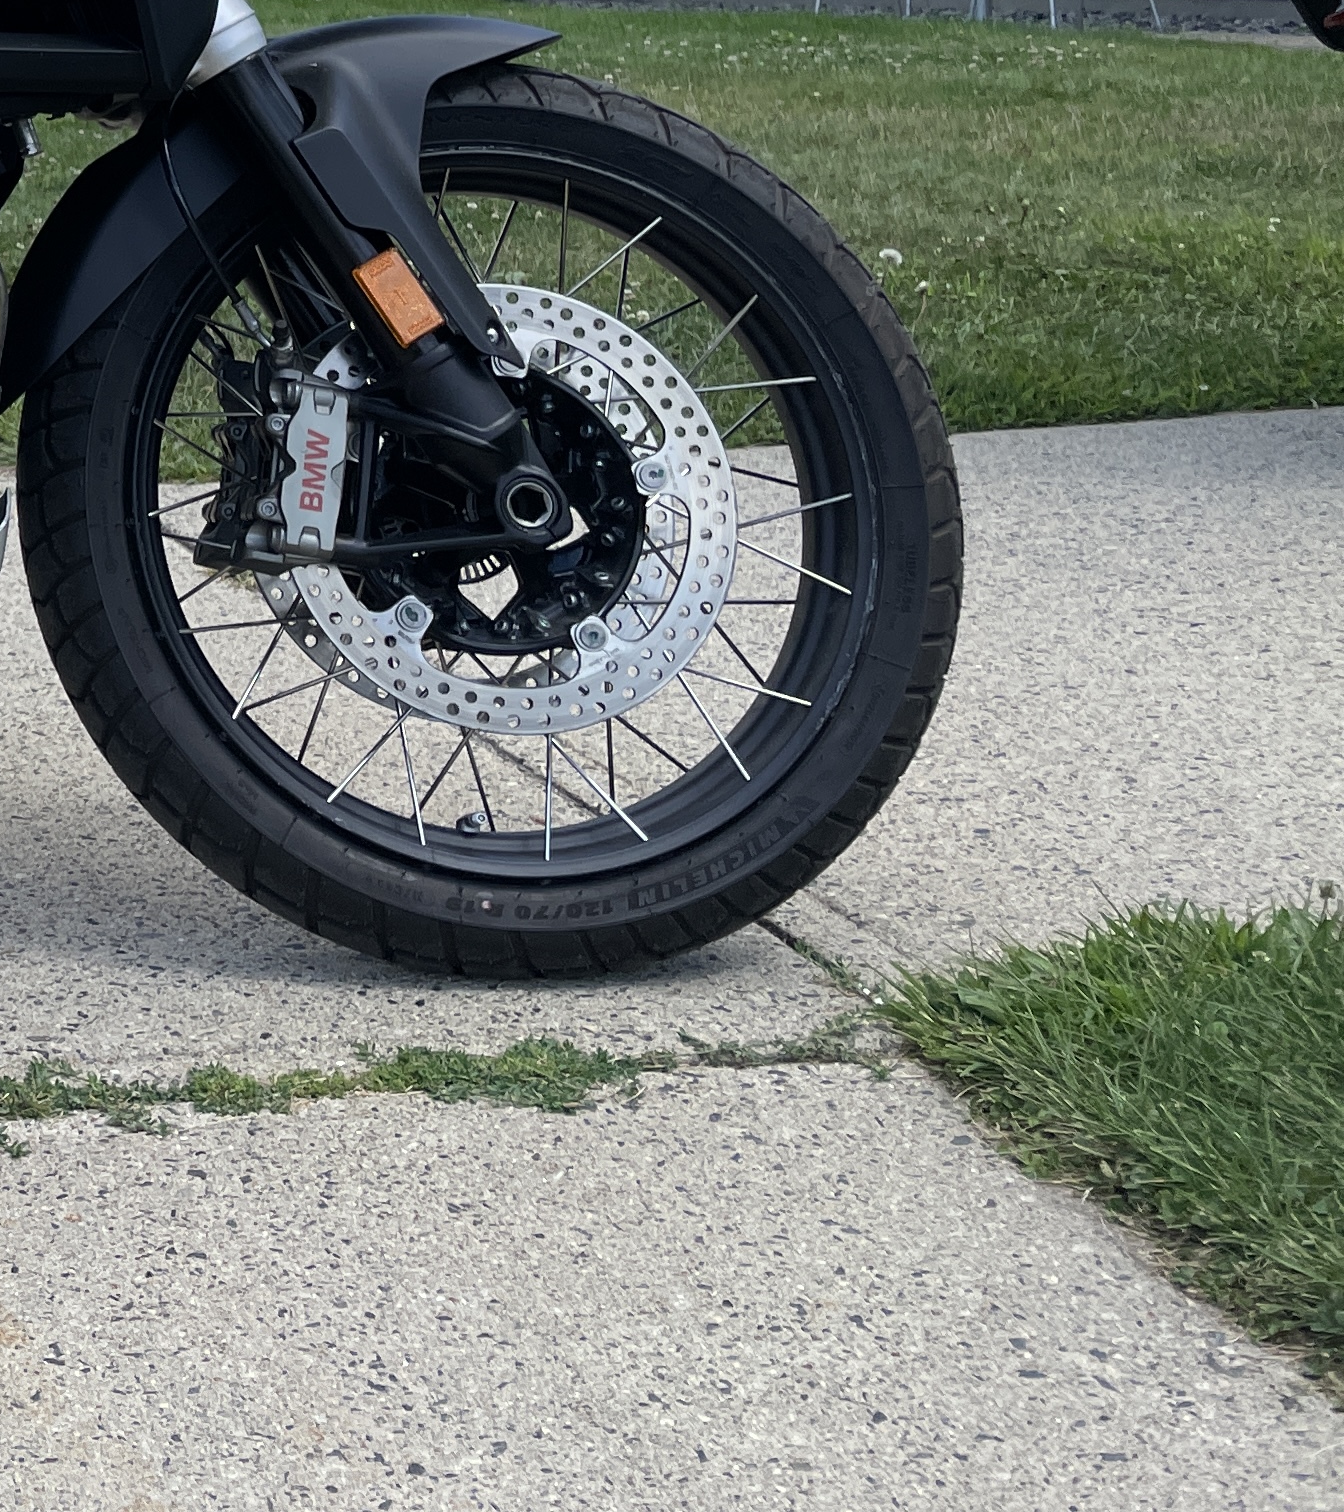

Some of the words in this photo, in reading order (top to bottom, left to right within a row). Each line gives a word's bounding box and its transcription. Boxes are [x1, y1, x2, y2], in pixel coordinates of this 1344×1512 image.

[299, 429, 330, 512] BMW
[637, 824, 782, 906] MICHELIN
[514, 899, 612, 920] 120/70
